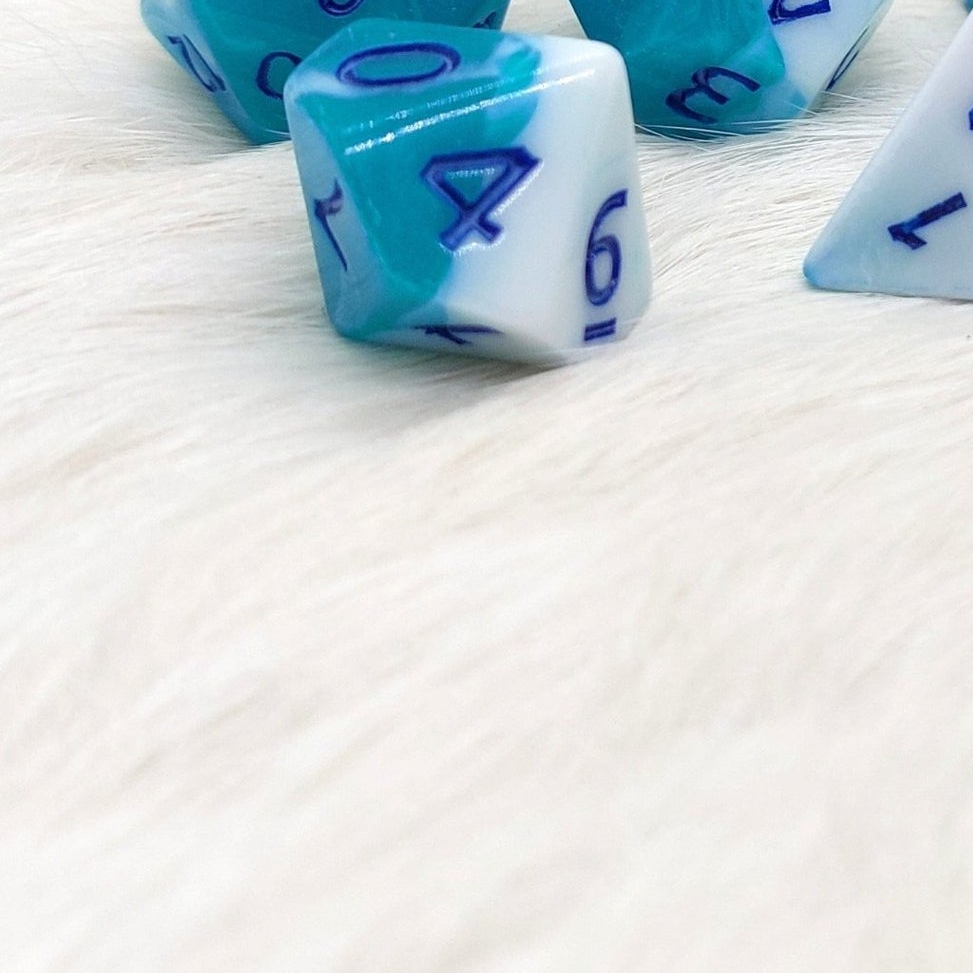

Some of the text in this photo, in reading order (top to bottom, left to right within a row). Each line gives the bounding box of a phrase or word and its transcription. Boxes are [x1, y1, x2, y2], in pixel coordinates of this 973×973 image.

[335, 42, 462, 89] 0
[665, 64, 762, 125] 3
[420, 146, 542, 252] 4
[887, 192, 968, 251] 1
